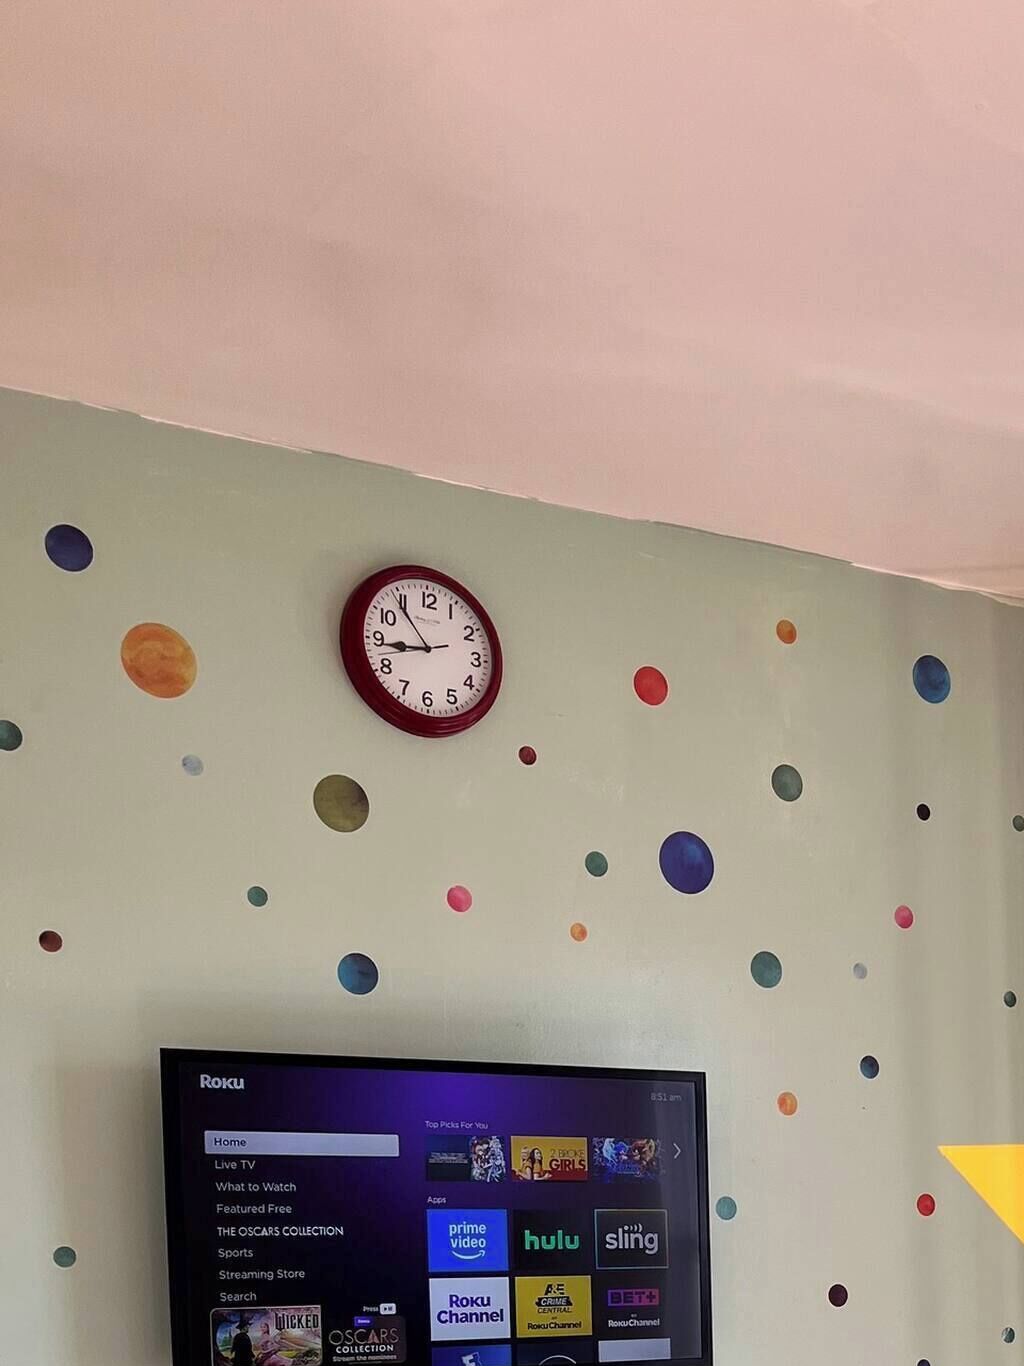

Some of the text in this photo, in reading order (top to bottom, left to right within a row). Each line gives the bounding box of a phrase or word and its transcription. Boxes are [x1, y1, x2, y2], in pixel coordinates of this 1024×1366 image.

[399, 593, 407, 610] 11
[422, 592, 437, 610] 12
[380, 608, 396, 626] 10
[449, 603, 453, 620] 1
[373, 631, 384, 647] 9
[463, 625, 475, 642] 2
[380, 658, 392, 674] 8
[470, 652, 481, 667] 3
[399, 679, 410, 695] 7
[463, 675, 475, 690] 4
[422, 691, 433, 707] 6
[446, 688, 457, 705] 5
[200, 1074, 245, 1089] Roku
[424, 1120, 488, 1130] Top Picks For You
[214, 1137, 247, 1147] Home
[214, 1160, 256, 1170] Live TV
[549, 1158, 586, 1171] GIRLS
[215, 1182, 297, 1192] What to Watch
[427, 1196, 447, 1204] Apps
[216, 1203, 292, 1214] Featured Free
[217, 1226, 344, 1236] THE OSCARS COLLECTION
[449, 1221, 487, 1236] prime
[450, 1236, 486, 1249] video
[524, 1229, 580, 1250] hulu
[605, 1225, 659, 1254] sling
[218, 1248, 254, 1259] Sports
[219, 1268, 306, 1280] Streaming Store
[219, 1291, 257, 1302] Search
[544, 1283, 565, 1296] A&E
[610, 1290, 657, 1304] BET+
[449, 1294, 491, 1308] Roku
[541, 1297, 568, 1306] CRIME
[275, 1311, 319, 1331] WICKED
[437, 1309, 504, 1324] Channel
[328, 1328, 400, 1346] OSCARS
[335, 1344, 394, 1354] COLLECTION
